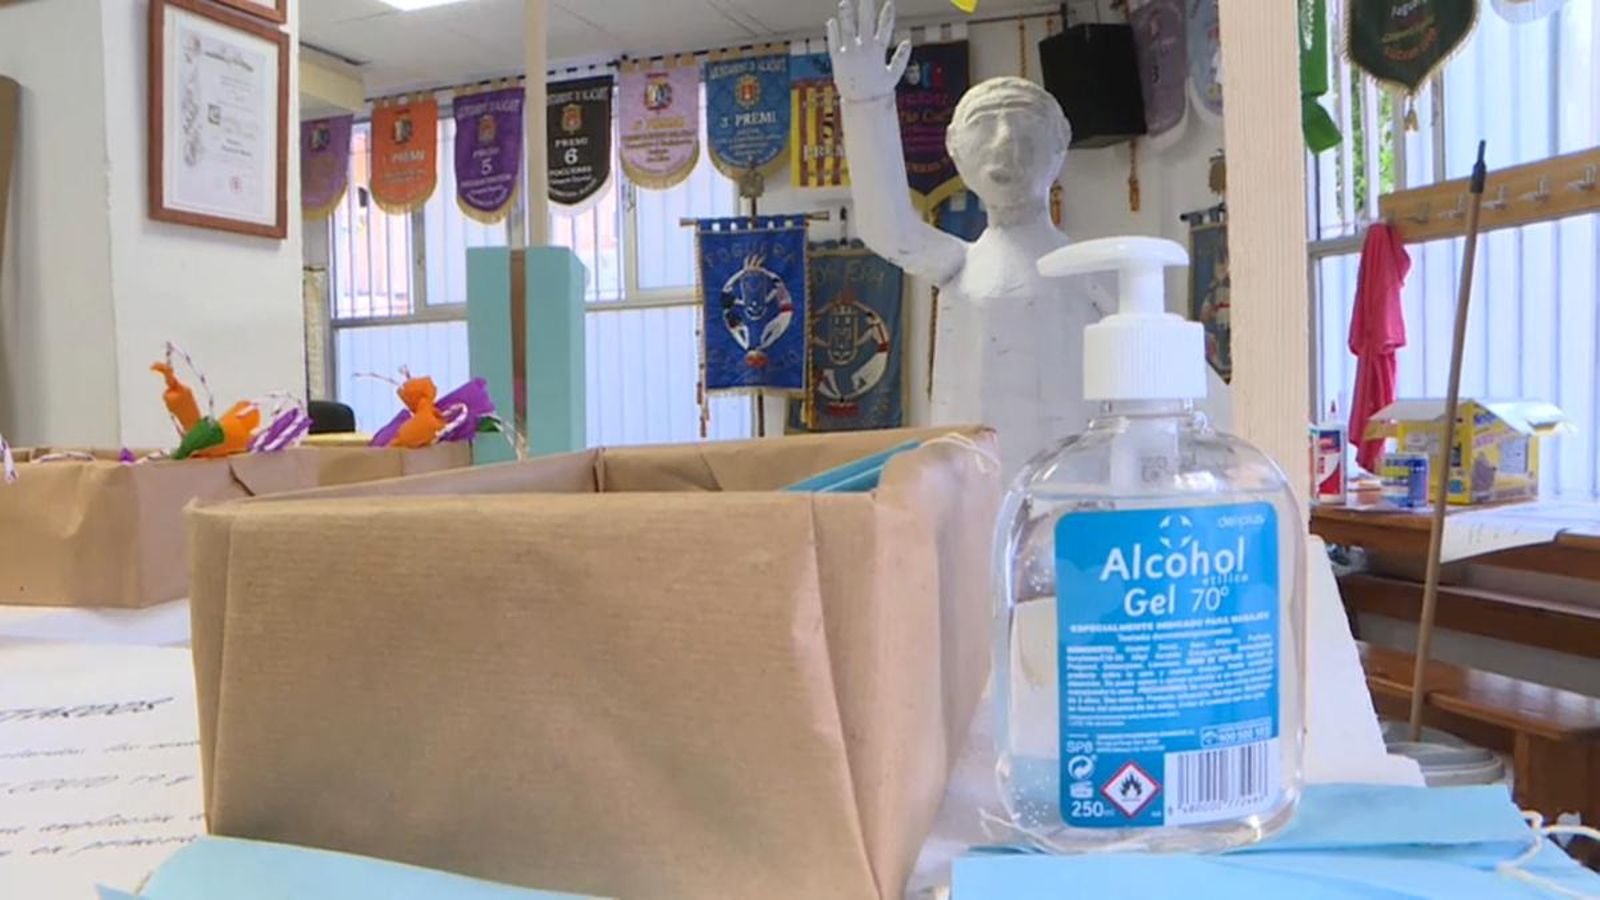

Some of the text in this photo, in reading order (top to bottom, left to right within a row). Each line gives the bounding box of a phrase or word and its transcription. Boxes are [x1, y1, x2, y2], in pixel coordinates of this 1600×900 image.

[735, 111, 777, 127] PREMI
[564, 147, 579, 165] 6
[480, 158, 493, 176] 5
[1099, 535, 1246, 581] Alcohol
[1123, 583, 1176, 617] Gel
